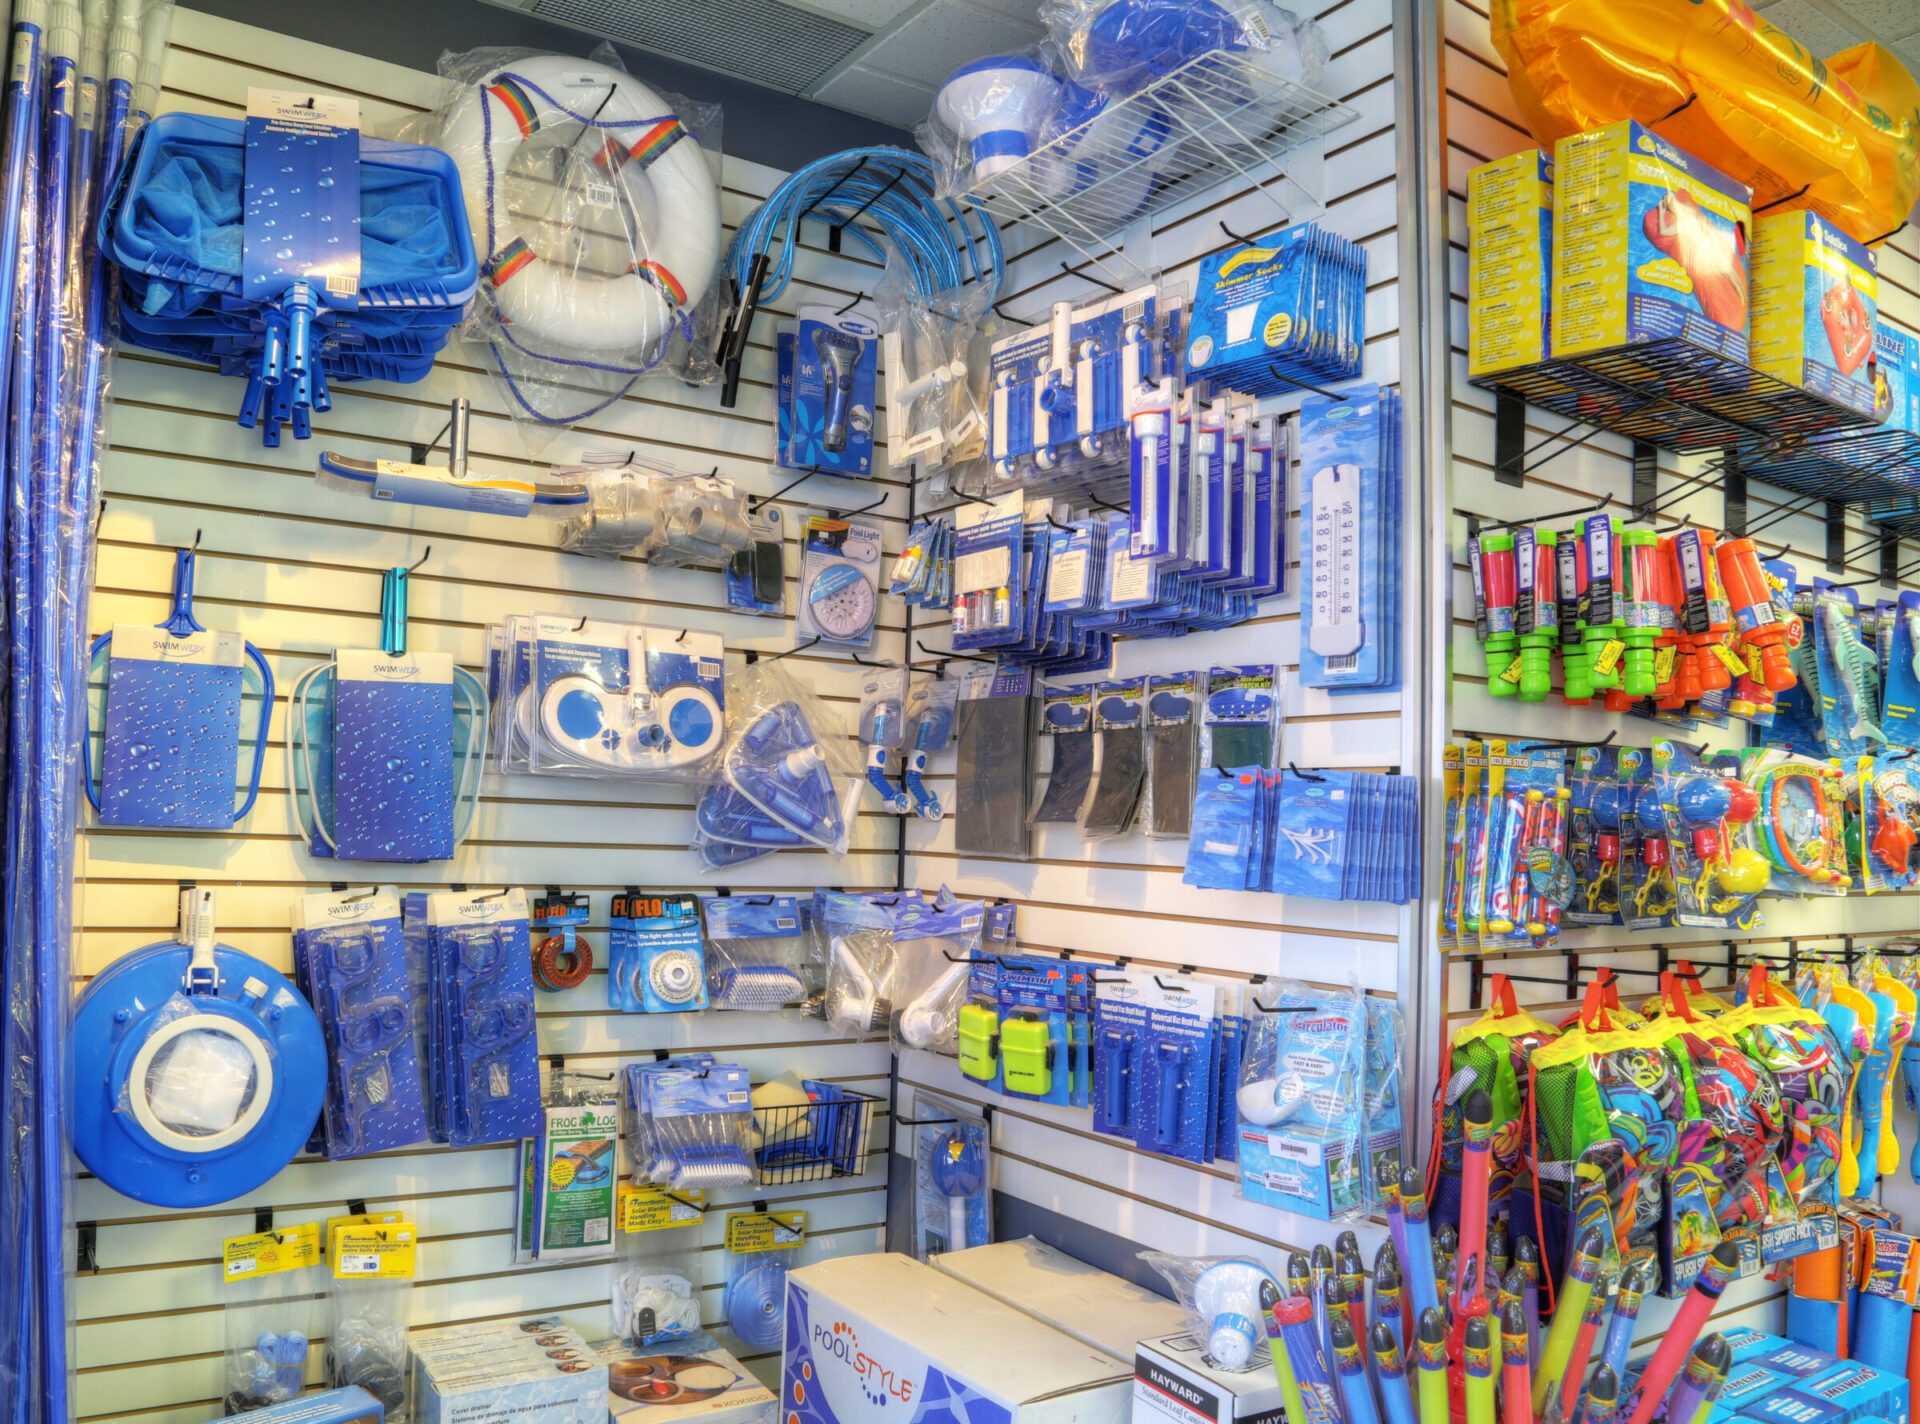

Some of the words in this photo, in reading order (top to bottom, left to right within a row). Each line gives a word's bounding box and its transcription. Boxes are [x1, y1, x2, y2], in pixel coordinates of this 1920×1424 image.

[1214, 272, 1254, 290] Skimmer
[1256, 263, 1284, 277] Socks
[1316, 513, 1329, 521] 120
[849, 527, 864, 538] Pool
[864, 529, 880, 540] Light
[1316, 528, 1329, 536] 100
[1316, 544, 1327, 552] 80
[1316, 559, 1327, 568] 60
[1315, 574, 1327, 582] 40
[1315, 590, 1327, 598] 20
[1320, 605, 1325, 613] 0
[153, 640, 206, 654] SWIMWERX
[373, 664, 421, 675] SWIMWERX
[551, 905, 567, 918] FLO
[613, 898, 627, 917] FL
[636, 898, 662, 917] FLO
[639, 932, 650, 940] The
[651, 932, 663, 941] light
[1151, 1012, 1174, 1022] Universal
[1173, 1015, 1181, 1024] Vac
[550, 1117, 577, 1129] FROG
[597, 1115, 616, 1126] LOG
[647, 1217, 665, 1225] Easy!
[1774, 1225, 1796, 1246] SPORTS
[1796, 1221, 1812, 1239] PACK
[1877, 1242, 1899, 1252] MAX
[1674, 1259, 1696, 1282] SPLASH
[1150, 1368, 1200, 1405] HAYWARD
[1141, 1385, 1169, 1408] Standard
[1169, 1402, 1184, 1417] Leaf
[451, 1414, 476, 1424] Sistema
[517, 1405, 533, 1414] agua
[533, 1403, 547, 1411] para
[1256, 1411, 1290, 1424] HAYW
